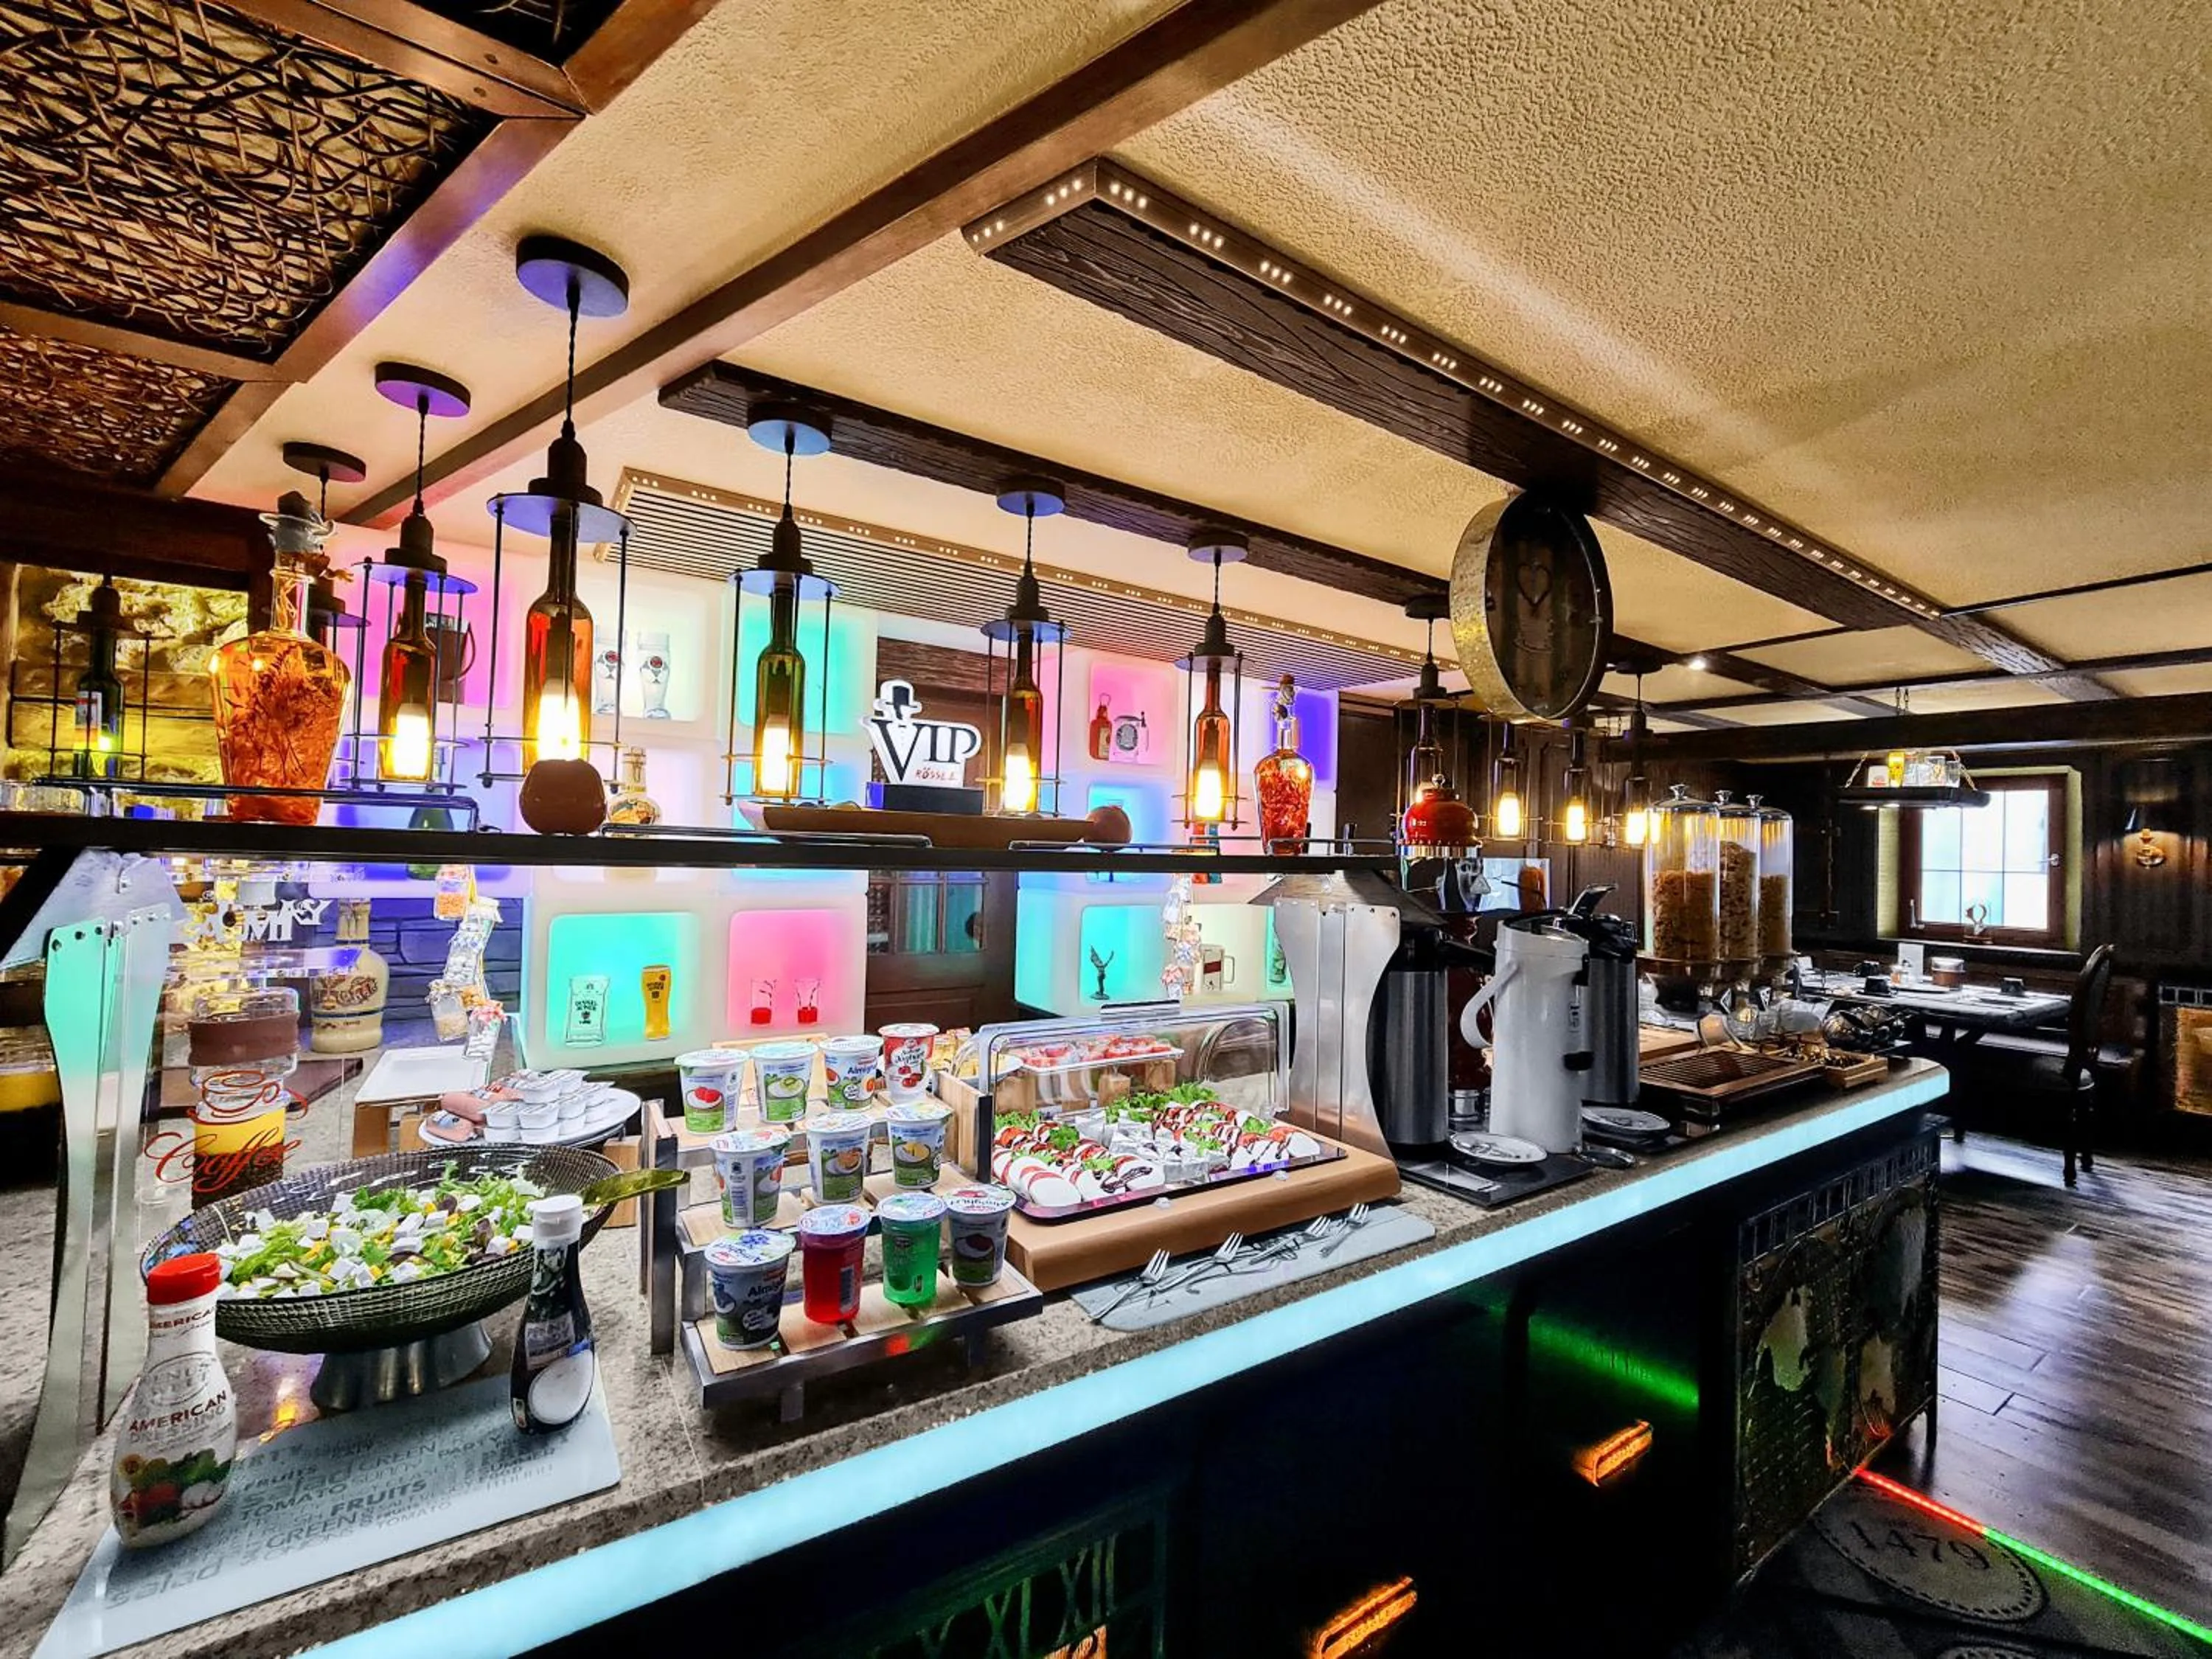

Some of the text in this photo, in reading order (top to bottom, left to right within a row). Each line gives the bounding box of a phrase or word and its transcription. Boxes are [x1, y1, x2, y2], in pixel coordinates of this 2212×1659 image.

[871, 719, 977, 782] VIP
[143, 1127, 302, 1192] Coffee
[129, 1389, 227, 1431] AMERICAN
